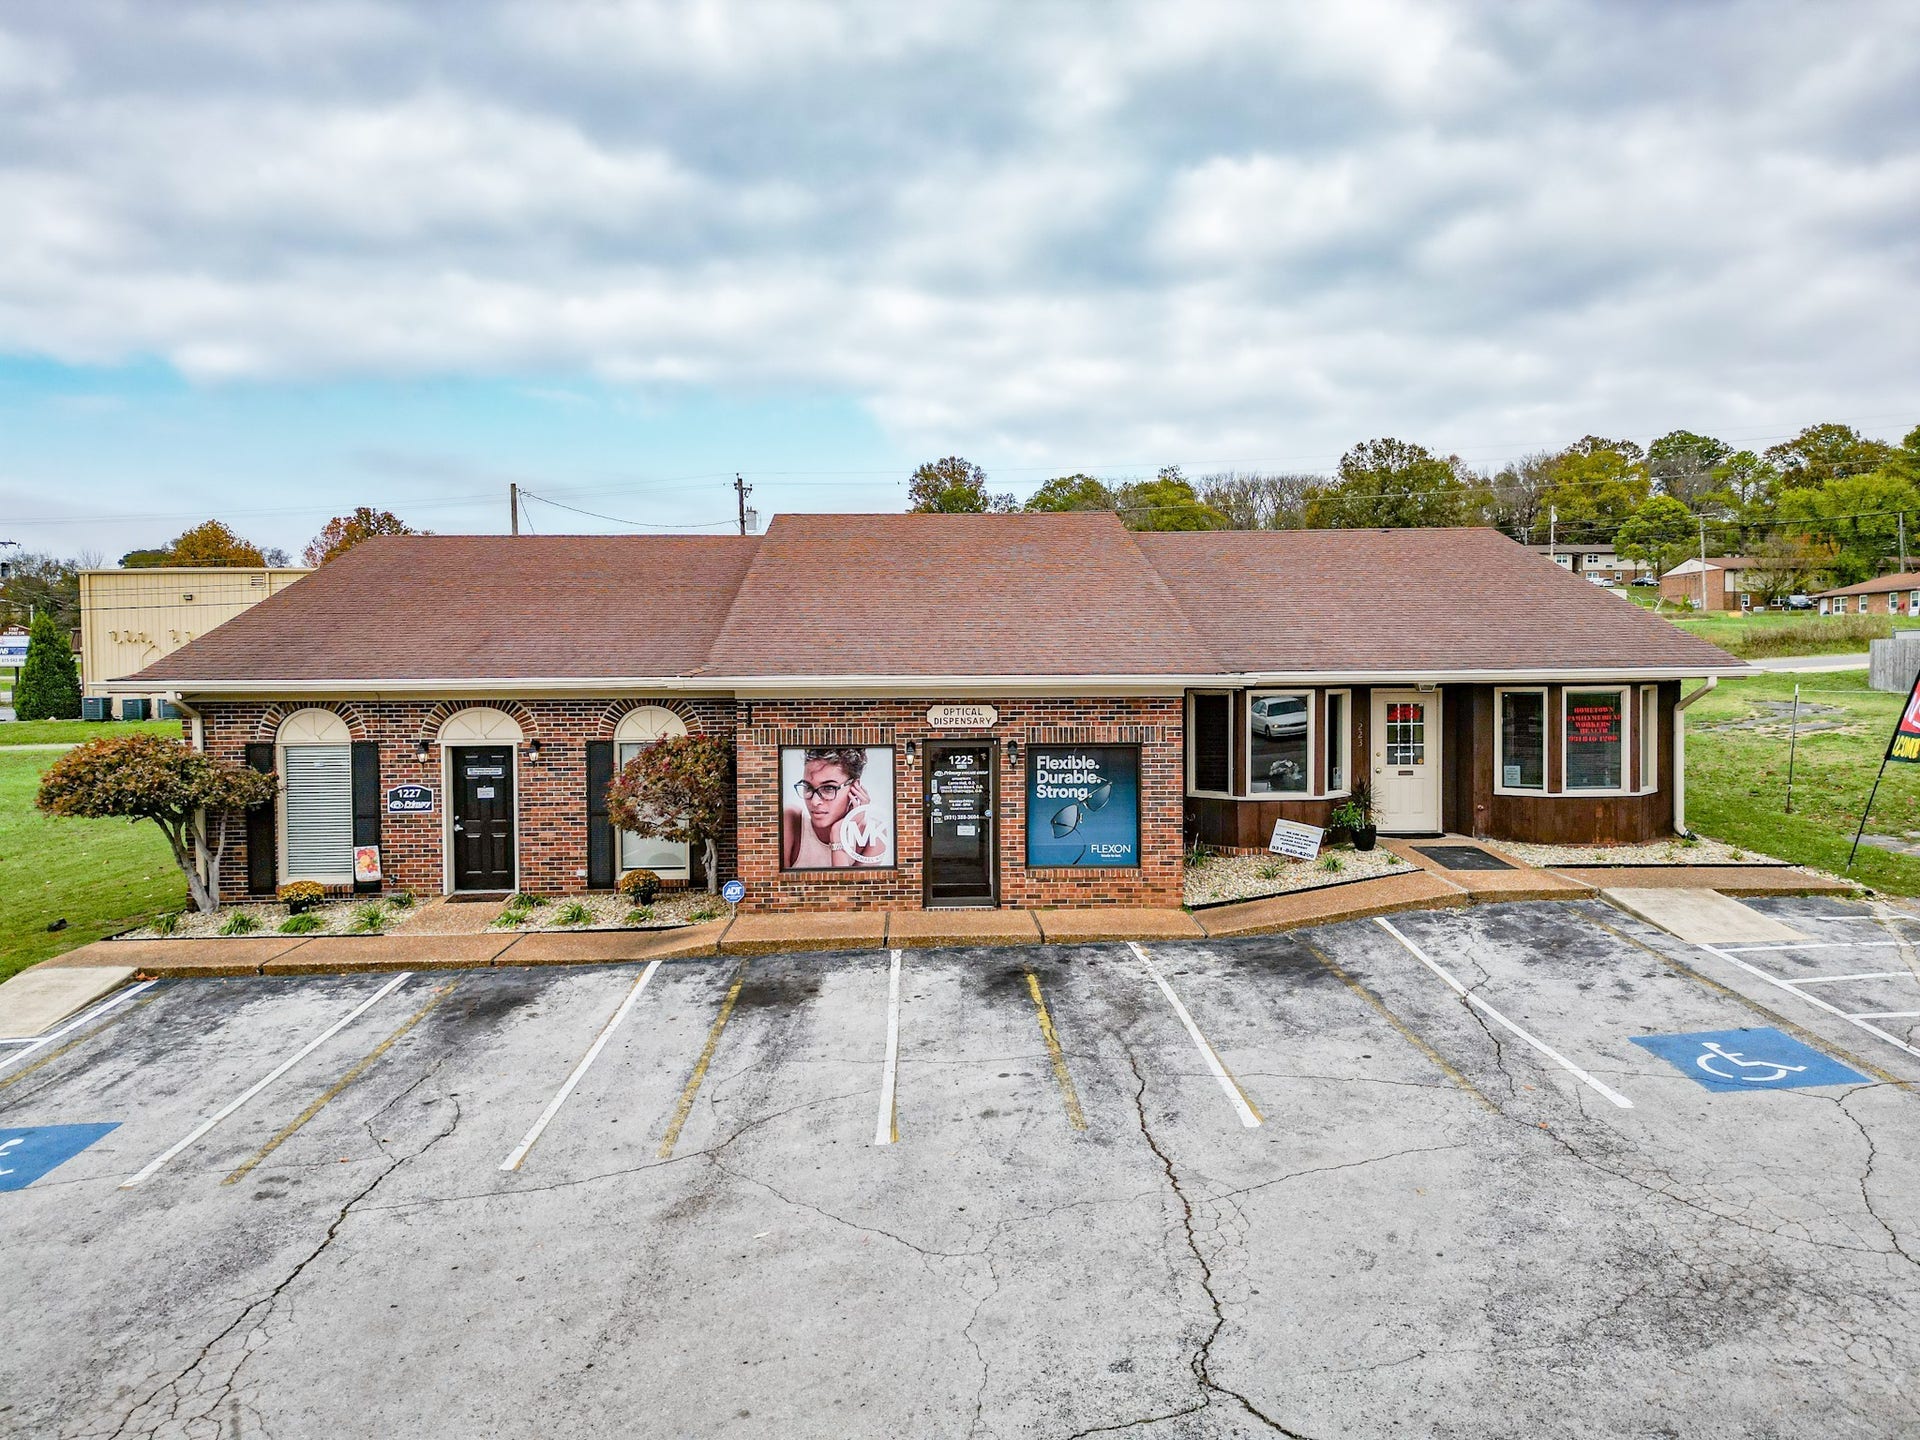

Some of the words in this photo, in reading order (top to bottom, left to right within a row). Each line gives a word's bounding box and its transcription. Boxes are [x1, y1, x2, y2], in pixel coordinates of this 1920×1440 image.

[943, 707, 983, 716] OPTICAL
[933, 717, 992, 725] DISPENSARY
[948, 755, 974, 765] 1225
[1036, 755, 1100, 770] Flexible.
[1036, 769, 1101, 784] Durable.
[397, 789, 421, 798] 1227
[1036, 784, 1092, 801] Strong.
[1091, 844, 1131, 854] FLEXON
[1271, 846, 1315, 858] 931-840-4200
[725, 886, 742, 896] ADT
